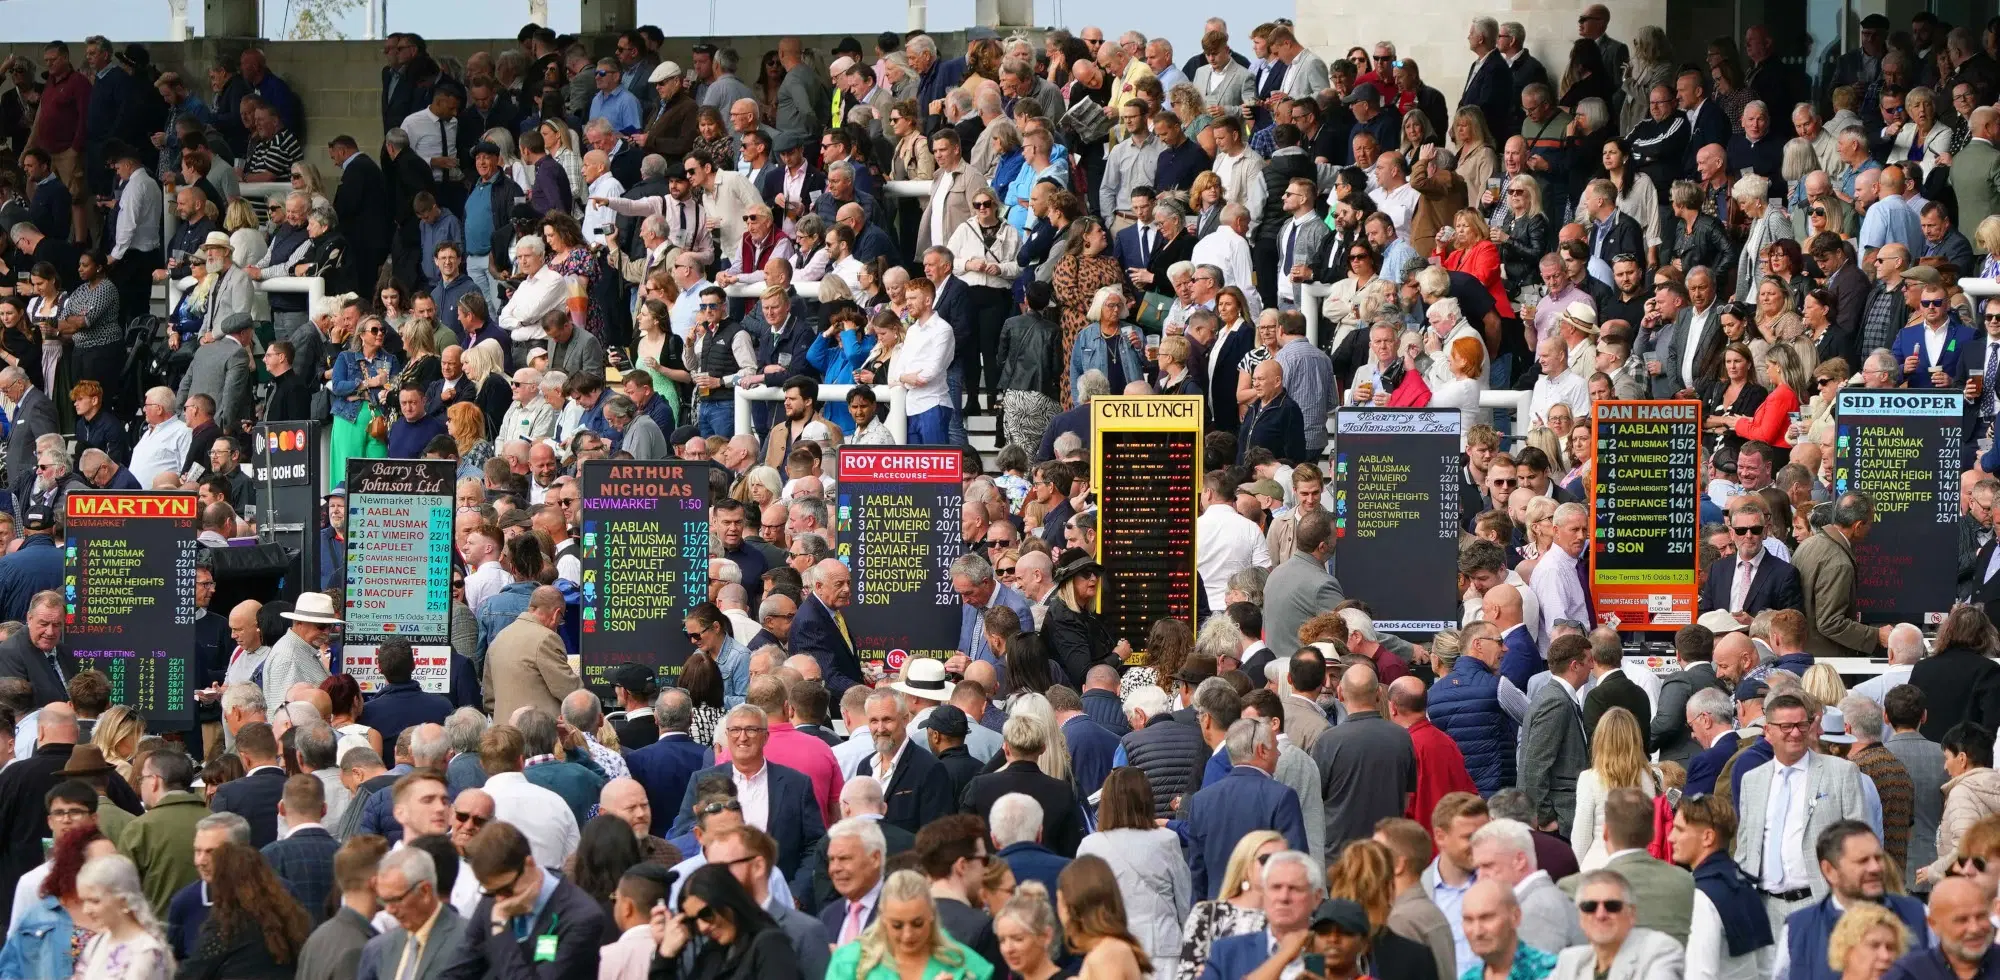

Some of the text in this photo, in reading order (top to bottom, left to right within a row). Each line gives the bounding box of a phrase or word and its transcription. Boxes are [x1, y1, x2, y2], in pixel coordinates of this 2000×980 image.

[1843, 396, 1956, 409] SID HOOPER
[1102, 403, 1193, 418] CYRIL LYNCH
[1598, 406, 1696, 419] DAN HAGUE
[1618, 424, 1696, 435] AABLAN 11/2
[1863, 427, 1962, 437] AABLAN 11/2
[1862, 438, 1961, 448] AL MUSMAK 7/1
[1618, 454, 1629, 462] AT
[1862, 449, 1920, 458] AT VIMEIRO
[845, 456, 954, 470] ROY CHRISTIE
[1358, 456, 1460, 464] AABLAN 11/2
[1862, 460, 1908, 469] CAPULET
[257, 464, 306, 481] SID HOOER
[372, 463, 430, 480] Barry R
[610, 466, 684, 480] ARTHUR
[1372, 465, 1410, 473] MUSMAK
[1618, 469, 1668, 478] CAPULET
[1372, 474, 1408, 482] VIMEIRO
[1440, 474, 1458, 482] 22/1
[1862, 470, 1898, 480] CAVIAR
[359, 478, 444, 492] Johnson Ltd
[1861, 481, 1910, 490] DEFIANCE
[601, 484, 692, 497] NICHOLAS
[360, 496, 442, 506] Newmarket 13:50
[584, 498, 702, 510] NEWMARKET 1:50
[866, 495, 962, 506] AABLAN 11/2
[1617, 498, 1668, 508] DEFIANCE
[76, 498, 189, 514] MARTYN
[367, 508, 451, 518] AABLAN 11/2
[866, 508, 882, 518] AL
[1936, 514, 1958, 523] 25/1
[366, 520, 450, 529] AL MUSMAK 7/1
[612, 522, 708, 532] AABLAN 11/2
[866, 520, 960, 531] AT VIMEIRO 20/1
[366, 530, 424, 540] AT VIMEIRO
[866, 532, 918, 543] CAPULET
[1439, 530, 1458, 538] 25/1
[1616, 528, 1667, 538] MACDUFF
[88, 540, 197, 549] AABLAN 11/2
[612, 534, 708, 545] AL 15/2
[366, 542, 414, 551] CAPULET
[866, 544, 908, 556] CAVIAR
[1616, 542, 1692, 554] SON 25/1
[88, 550, 196, 558] AL MUSMAK 8/1
[612, 547, 676, 557] AT VIMEIRO
[88, 559, 141, 567] AT VIMEIRO
[612, 559, 664, 570] CAPULET
[866, 557, 922, 568] DEFIANCE
[88, 568, 131, 576] CAPULET
[366, 566, 416, 574] DEFIANCE
[88, 578, 165, 586] CAVIAR HEIGHTS
[612, 572, 654, 582] CAVIAR
[88, 588, 134, 596] DEFIANCE
[612, 584, 706, 594] DEFIANCE 14/1
[866, 582, 922, 592] MACDUFF
[364, 589, 414, 598] MACDUFF
[88, 597, 155, 605] GHOSTWRITER
[866, 594, 960, 605] SON 28/1
[88, 606, 133, 614] MACDUFF
[427, 602, 447, 610] 25/1
[612, 608, 668, 618] MACDUFF
[88, 616, 108, 624] SON
[612, 620, 636, 631] SON
[73, 650, 166, 658] RECAST BETTING 1:50
[872, 650, 886, 658] MIN
[658, 666, 668, 676] £5
